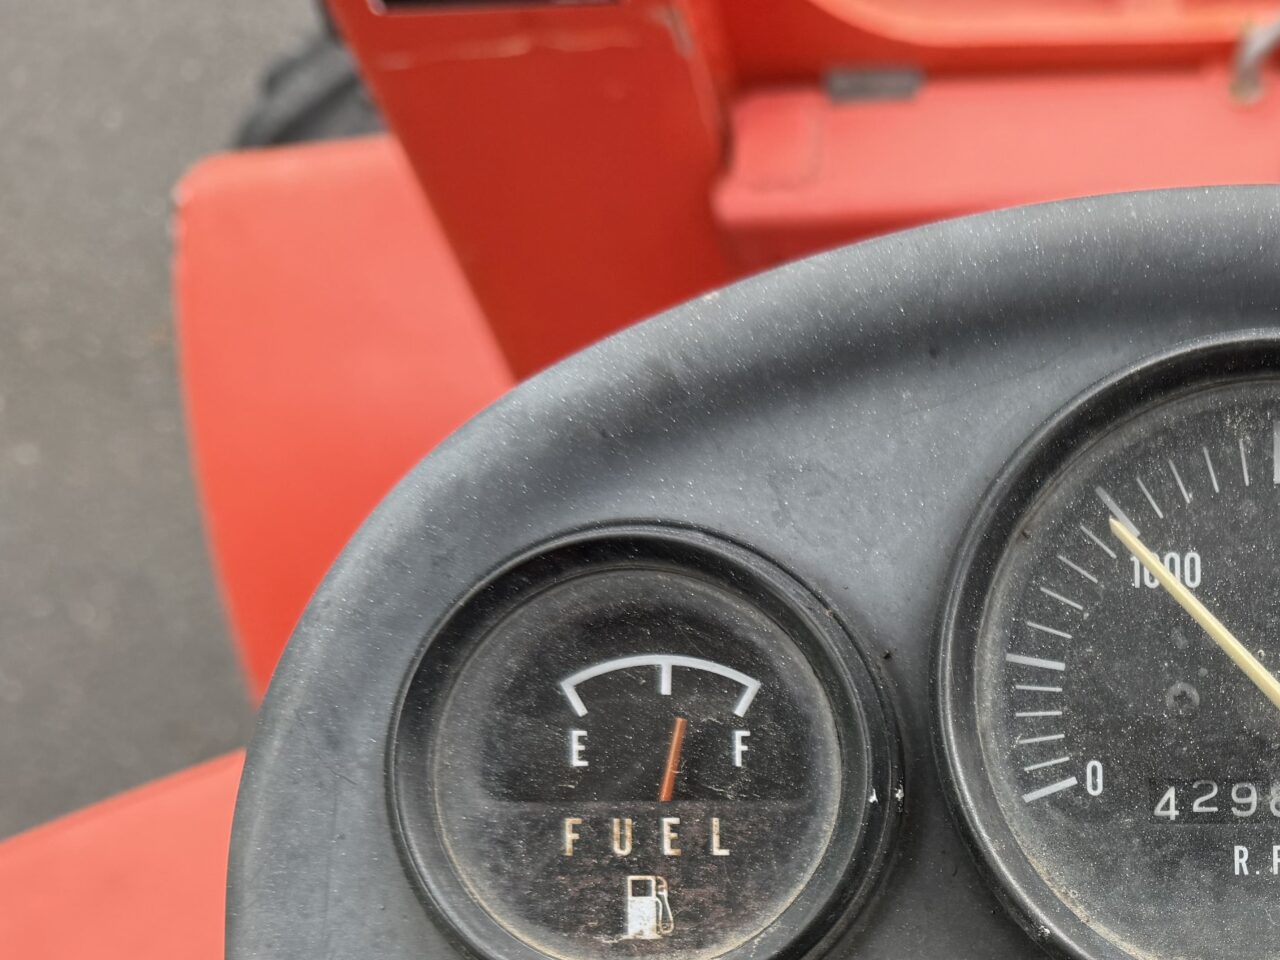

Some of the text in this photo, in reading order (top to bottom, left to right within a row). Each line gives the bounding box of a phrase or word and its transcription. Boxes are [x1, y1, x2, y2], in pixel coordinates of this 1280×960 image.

[570, 731, 589, 767] E
[733, 731, 751, 767] F
[1085, 761, 1103, 796] 0
[564, 818, 730, 856] FUEL
